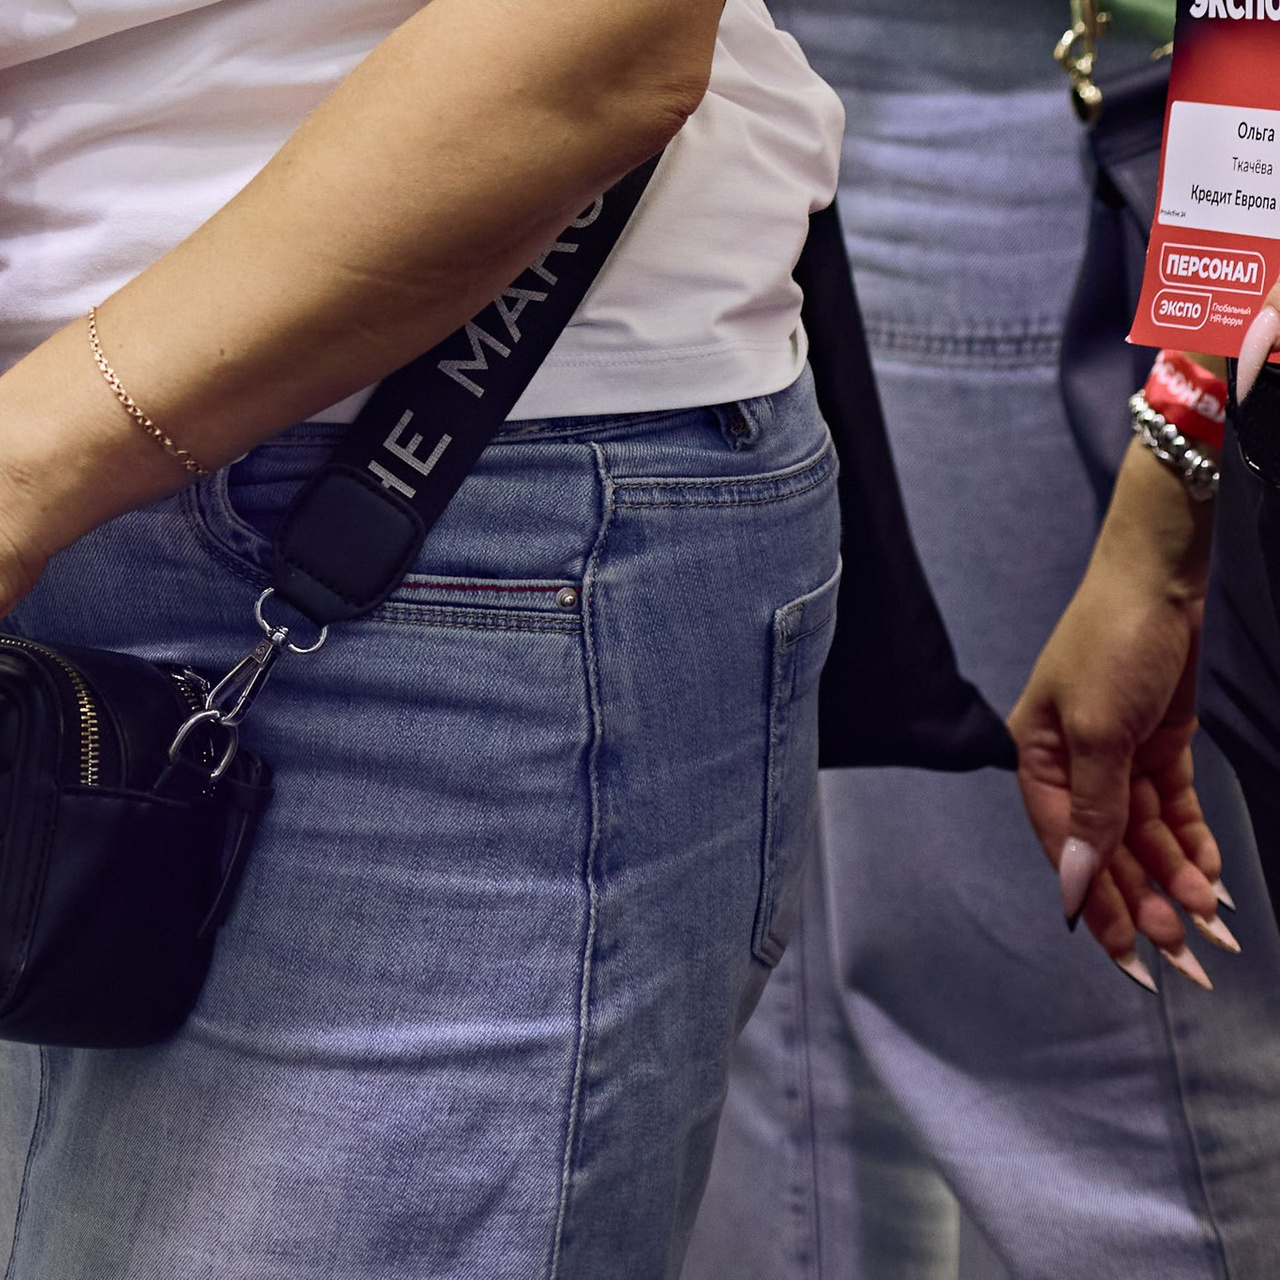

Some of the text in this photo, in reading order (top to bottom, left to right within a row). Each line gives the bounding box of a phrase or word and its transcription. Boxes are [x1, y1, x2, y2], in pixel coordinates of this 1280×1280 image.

[1237, 121, 1276, 142] Ольга
[1232, 156, 1274, 176] Ткачёва
[1190, 184, 1277, 211] Кредит Европа
[1166, 253, 1259, 284] ПЕРСОНАЛ
[1158, 299, 1202, 319] ЭКСПО
[1211, 302, 1253, 316] Глобальный
[1209, 314, 1244, 328] HR-форум
